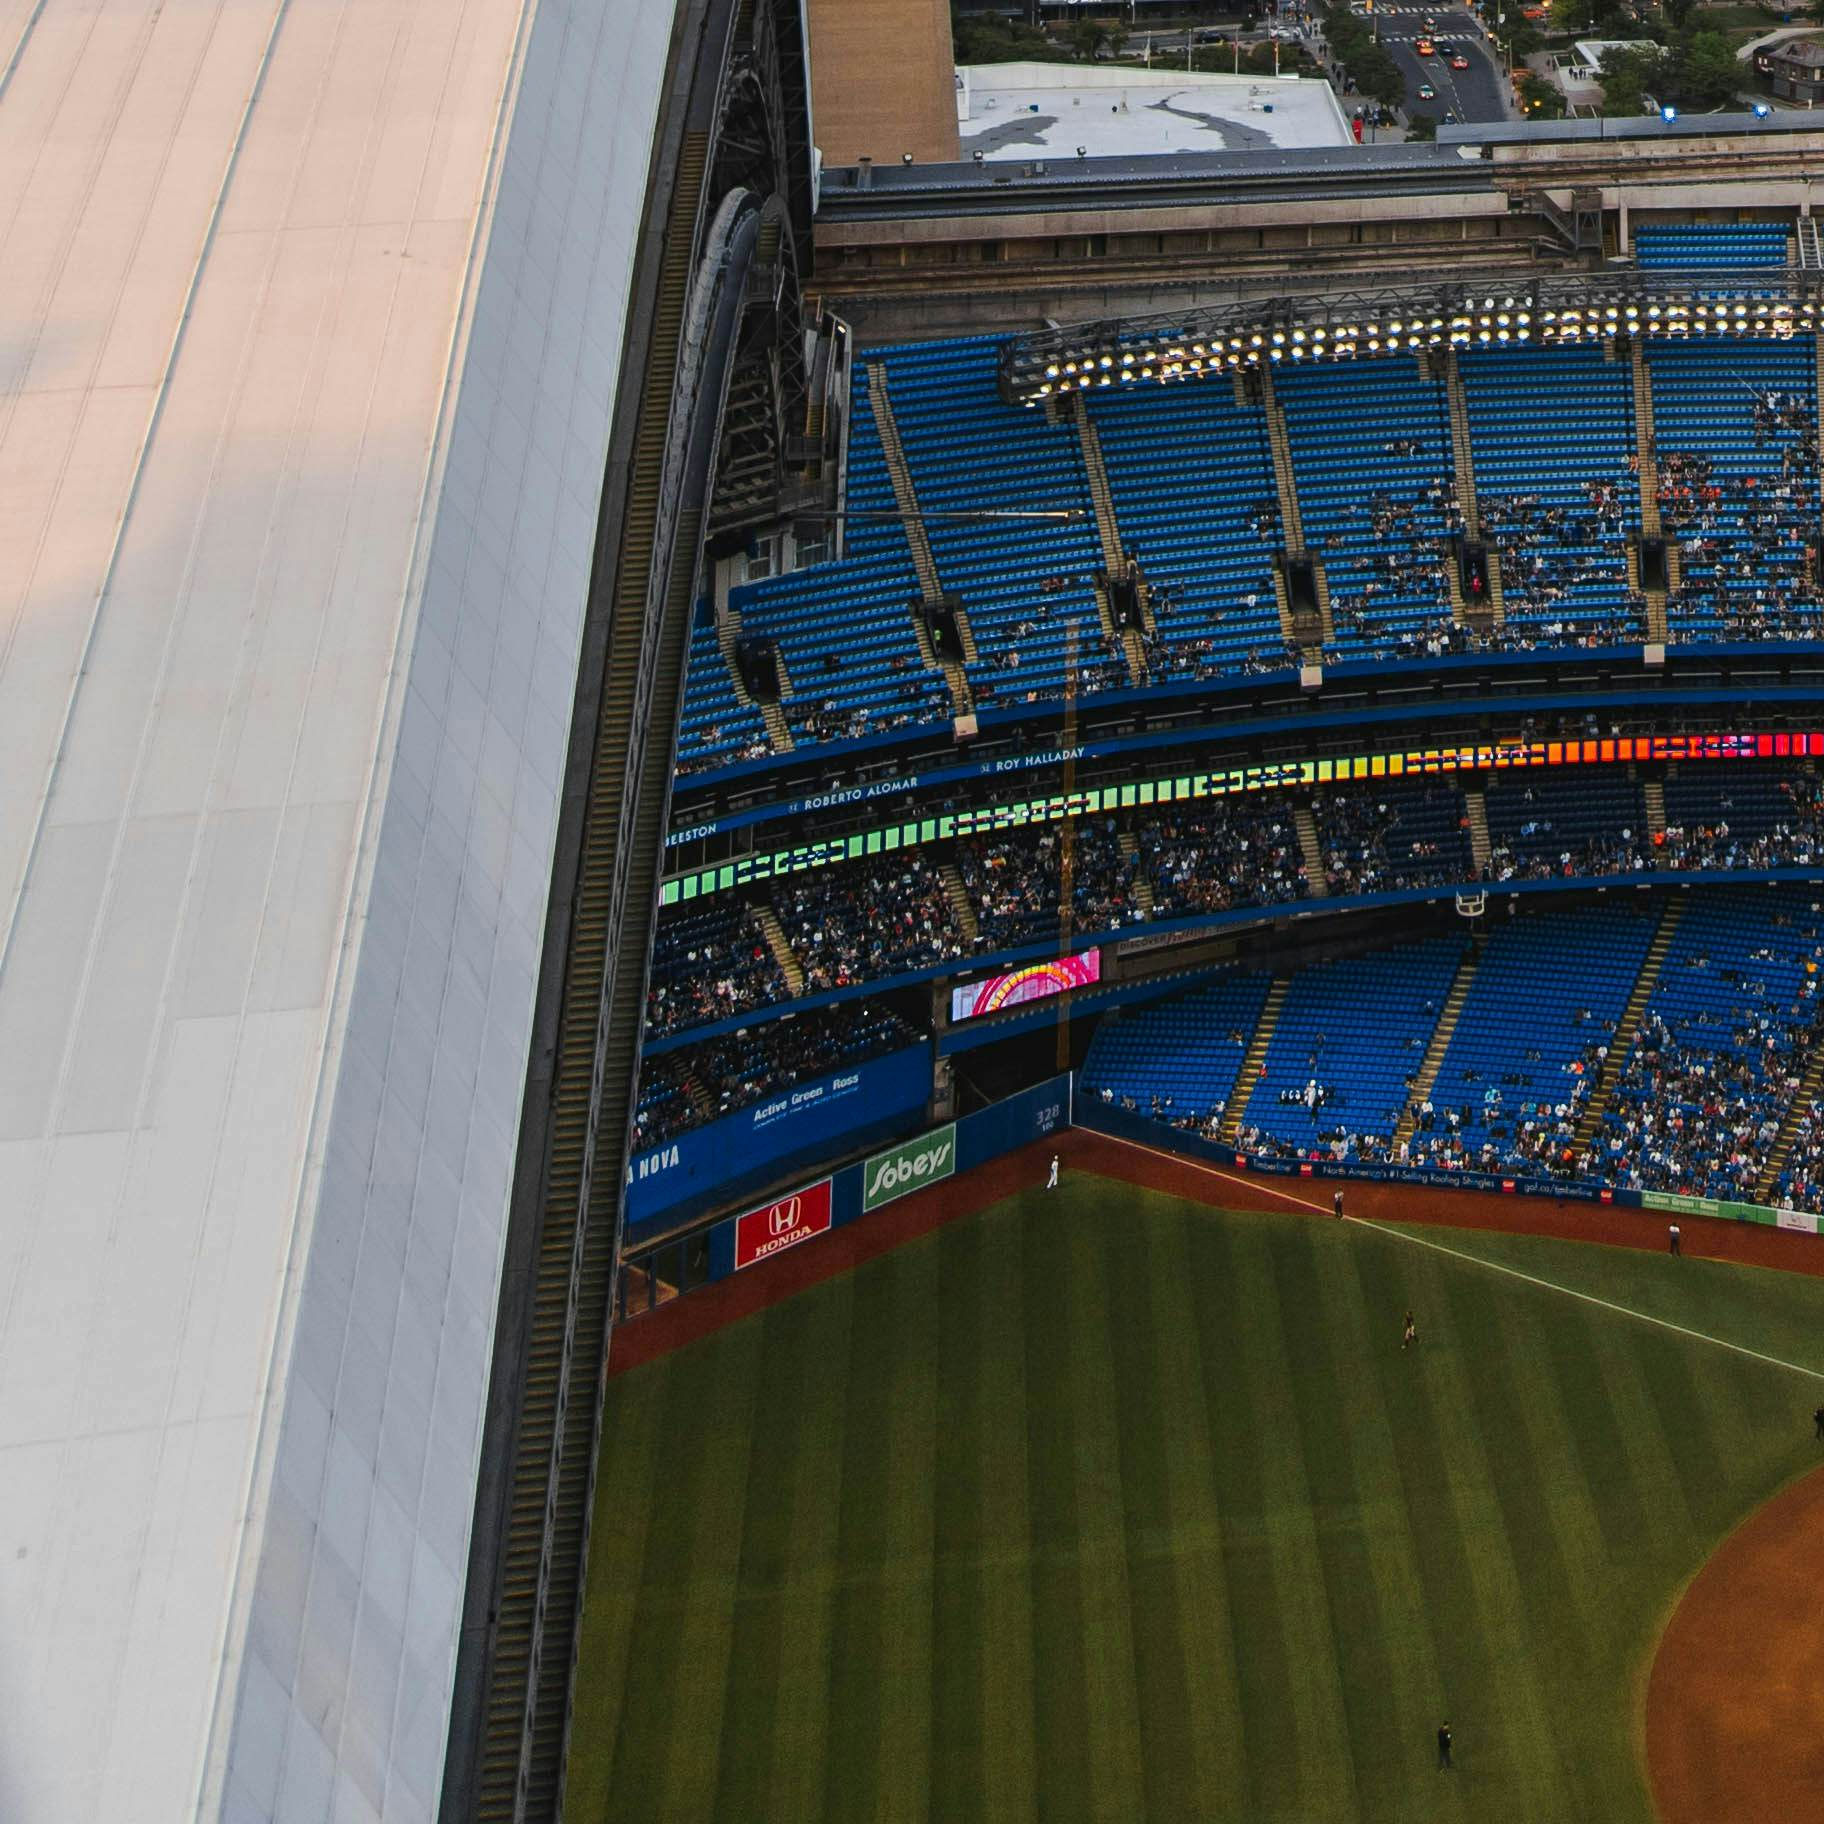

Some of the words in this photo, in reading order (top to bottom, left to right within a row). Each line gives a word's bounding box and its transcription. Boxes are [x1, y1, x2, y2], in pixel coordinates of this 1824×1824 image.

[996, 758, 1020, 772] ROY
[1025, 747, 1085, 767] HALLADAY
[804, 789, 862, 811] ROBERTO
[867, 777, 918, 798] ALOMAR
[754, 1100, 788, 1122] Active
[791, 1087, 823, 1105] Green
[833, 1074, 859, 1091] Ross
[1036, 1103, 1060, 1126] 328
[639, 1145, 680, 1179] NOVA
[868, 1142, 952, 1198] Sobeys
[1462, 1176, 1495, 1189] Shingles
[755, 1226, 813, 1258] HONDA
